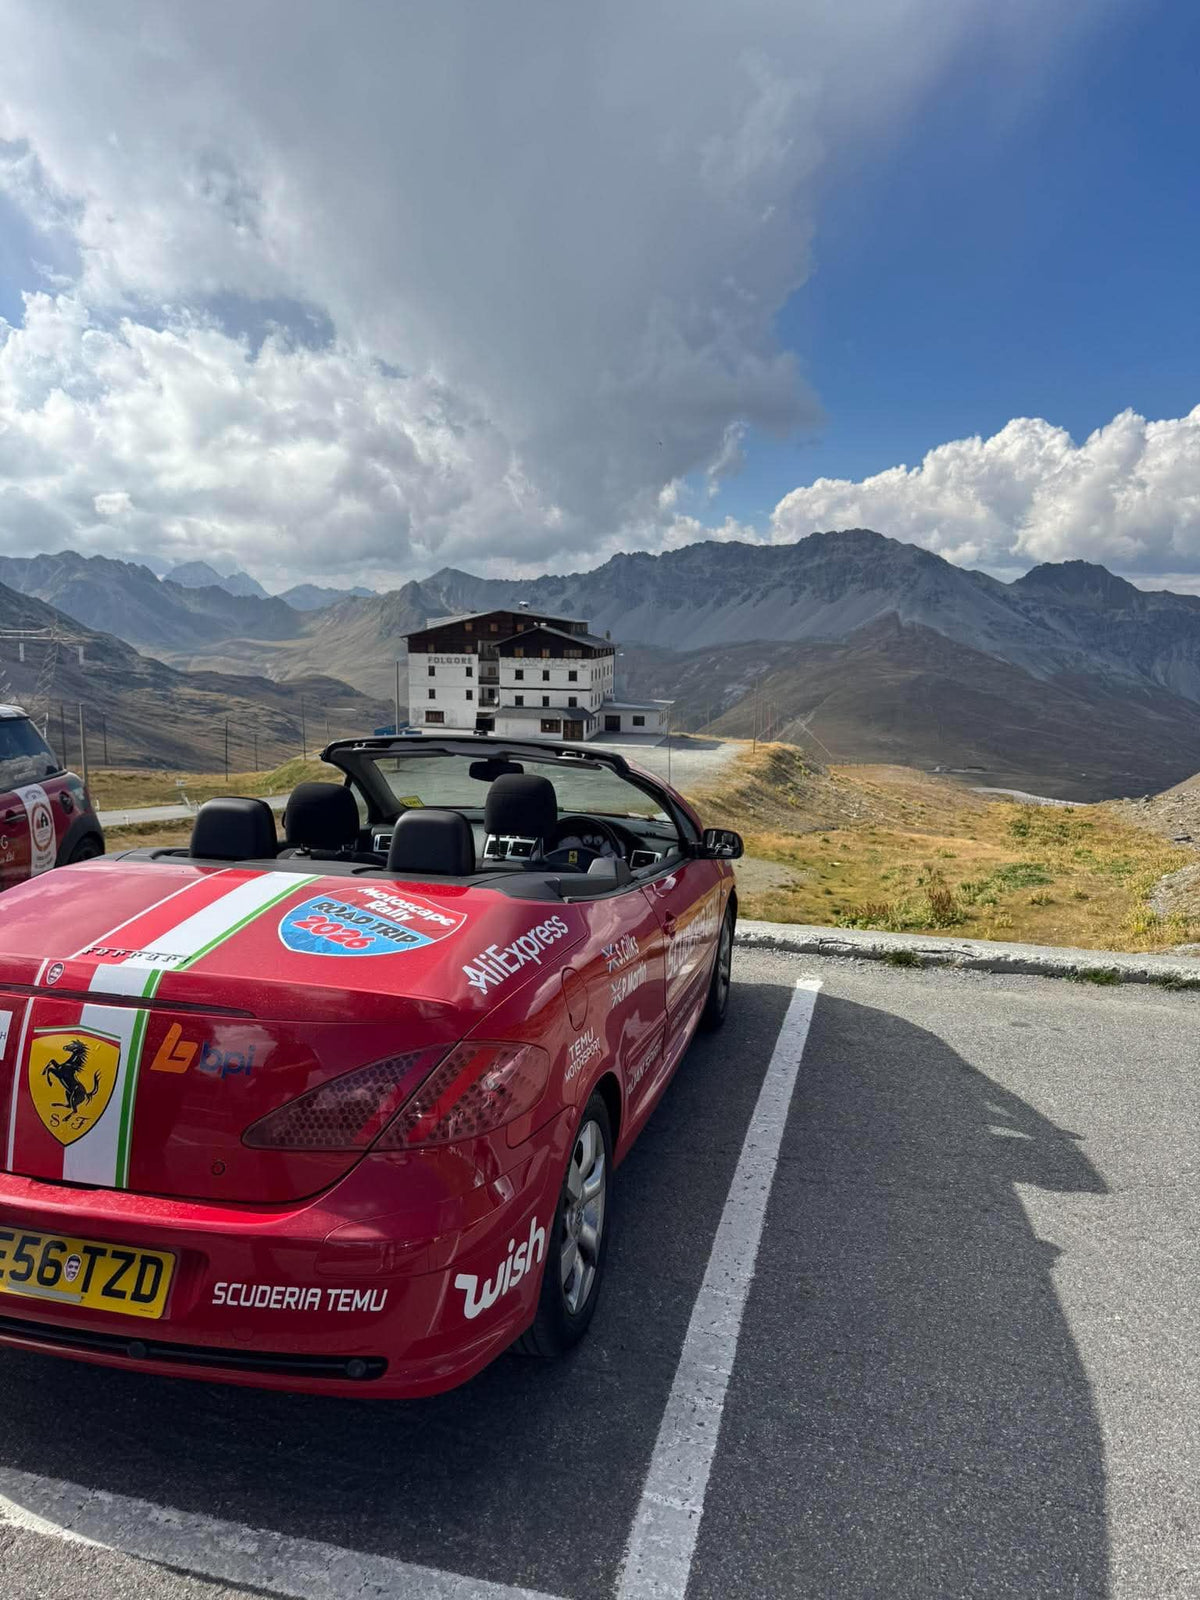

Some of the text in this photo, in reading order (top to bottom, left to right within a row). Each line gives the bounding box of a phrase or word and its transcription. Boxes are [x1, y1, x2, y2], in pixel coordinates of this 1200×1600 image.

[311, 901, 420, 943] ROAD TRIP
[357, 887, 456, 926] Motoscape
[364, 901, 415, 922] Rally
[291, 915, 375, 949] 2026
[462, 915, 569, 995] AliExpress
[201, 1041, 257, 1079] bpi
[564, 1037, 600, 1083] MOTORSPORT
[569, 1026, 593, 1061] TEMU
[81, 1245, 164, 1303] TZD
[454, 1216, 545, 1319] wish
[212, 1282, 388, 1312] SCUDERIA TEMU
